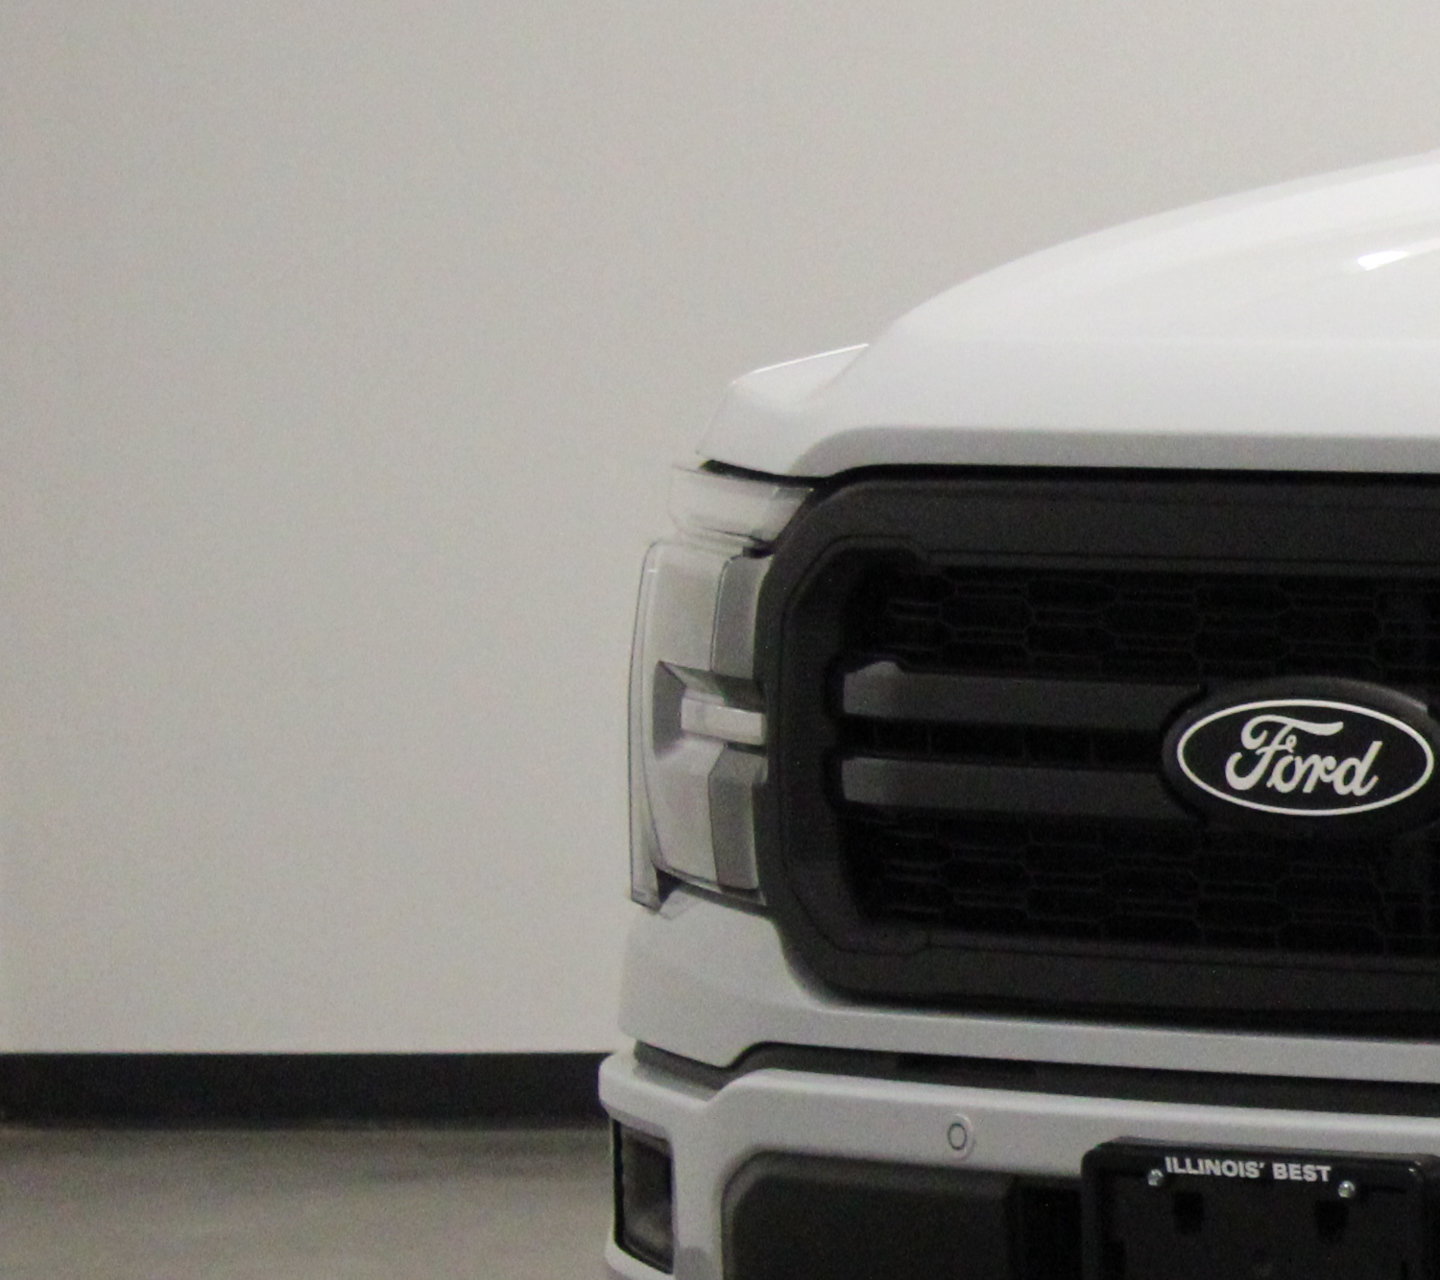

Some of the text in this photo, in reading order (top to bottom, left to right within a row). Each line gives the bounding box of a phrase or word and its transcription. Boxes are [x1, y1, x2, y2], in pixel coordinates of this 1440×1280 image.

[1225, 714, 1383, 797] Ford
[1165, 1156, 1332, 1182] ILLINOIS' BEST
